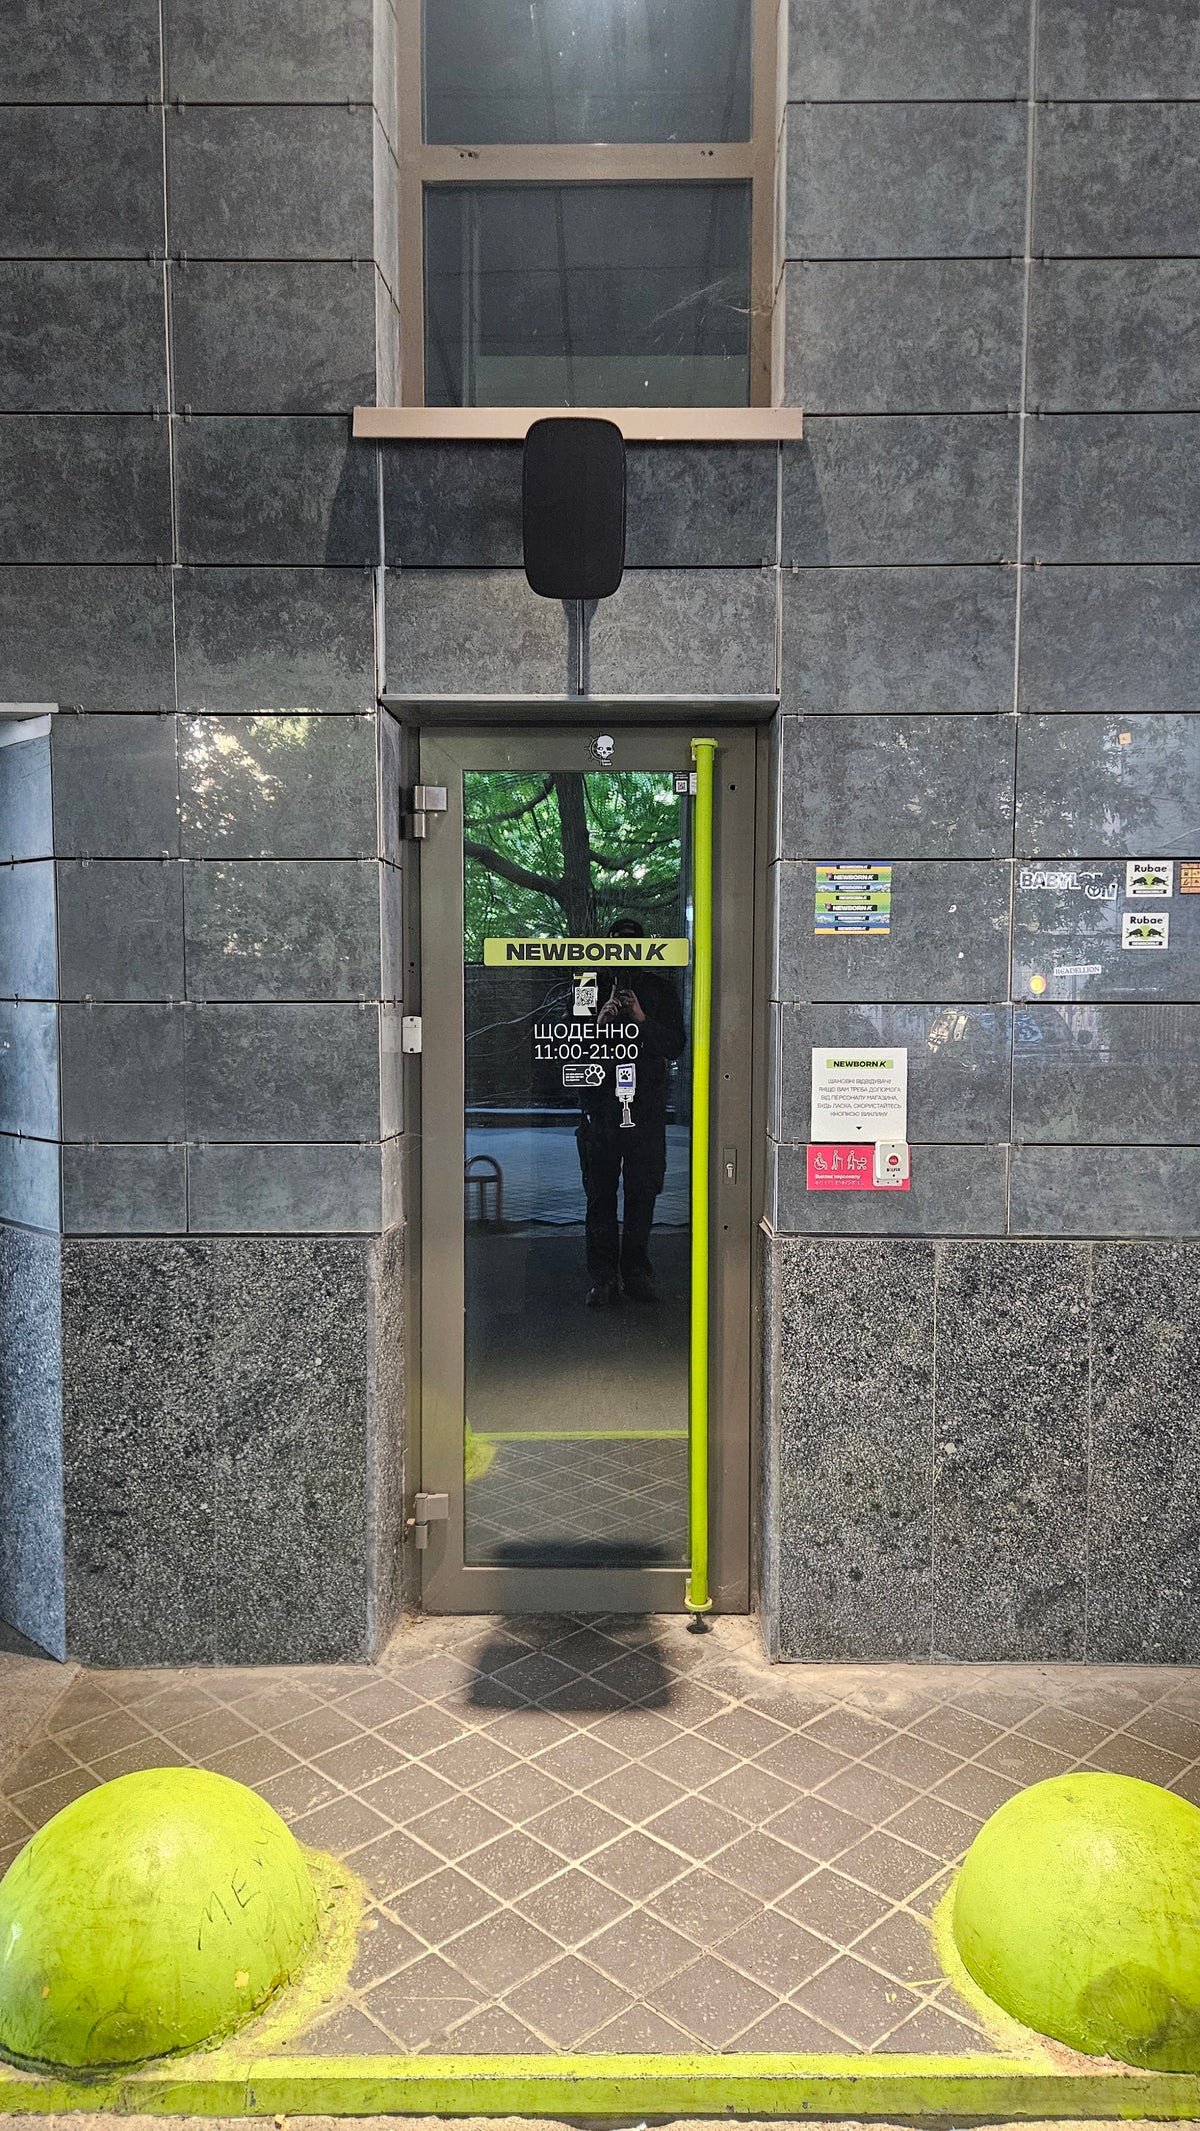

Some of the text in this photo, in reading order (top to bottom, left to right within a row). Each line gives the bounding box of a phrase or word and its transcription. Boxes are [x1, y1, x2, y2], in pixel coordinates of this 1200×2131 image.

[1134, 864, 1167, 872] Rubae
[1130, 916, 1163, 924] Rubae
[534, 1023, 640, 1042] ЩОДЕННО
[534, 1044, 639, 1060] 11:00-21:00
